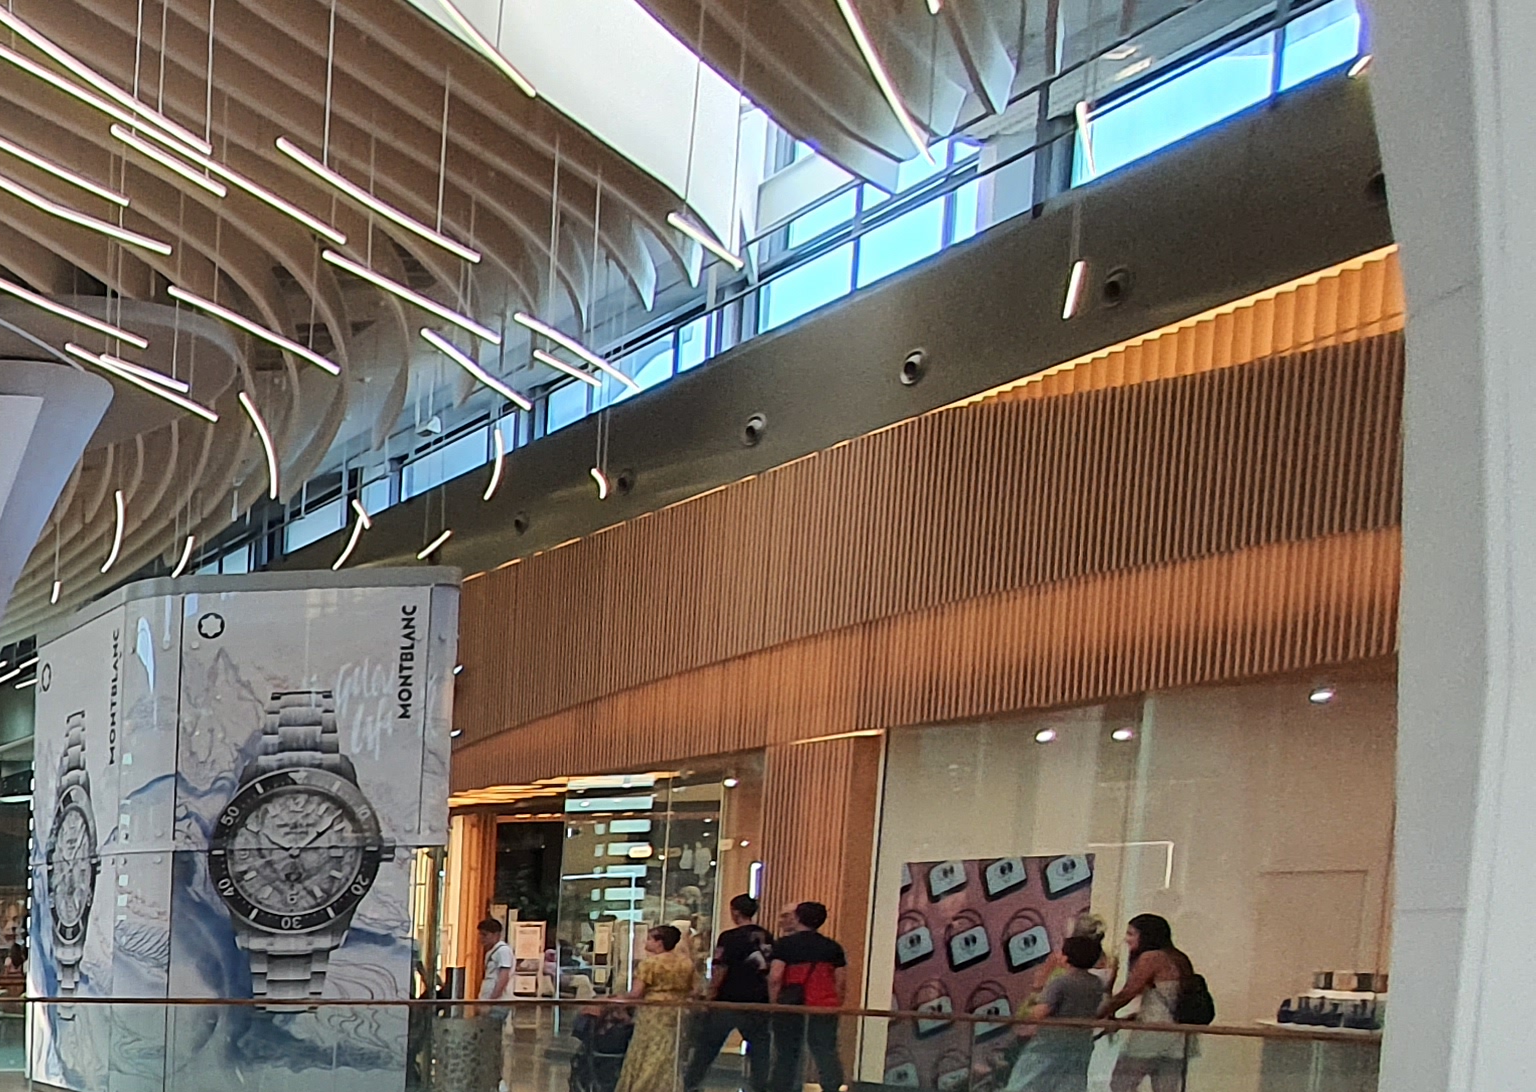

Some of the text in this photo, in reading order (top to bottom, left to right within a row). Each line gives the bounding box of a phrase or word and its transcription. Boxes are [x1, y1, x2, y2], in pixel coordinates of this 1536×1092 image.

[398, 604, 417, 719] MONTBLANC
[108, 627, 120, 766] MONTBLANC
[221, 805, 240, 827] 50
[218, 877, 236, 898] 40
[350, 873, 370, 897] 20
[280, 915, 303, 930] 30
